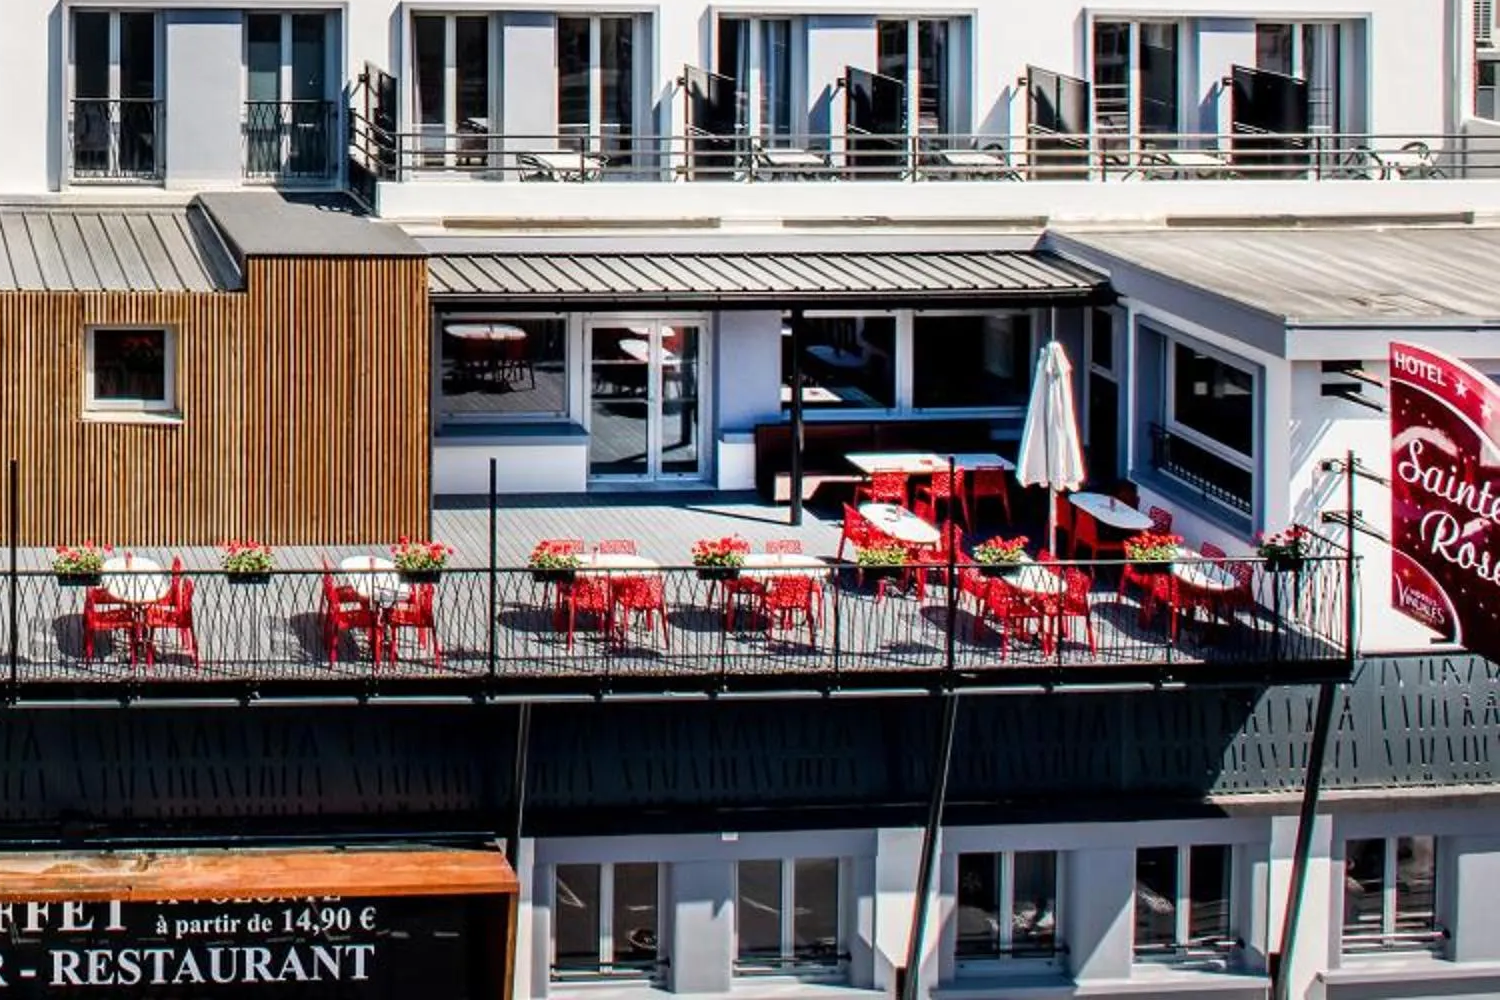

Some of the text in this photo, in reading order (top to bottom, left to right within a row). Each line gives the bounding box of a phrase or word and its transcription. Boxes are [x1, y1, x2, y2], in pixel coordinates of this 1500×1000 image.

[1395, 351, 1447, 387] HOTEL
[155, 906, 377, 939] à partir de 14,90 €
[49, 944, 376, 988] RESTAURANT
